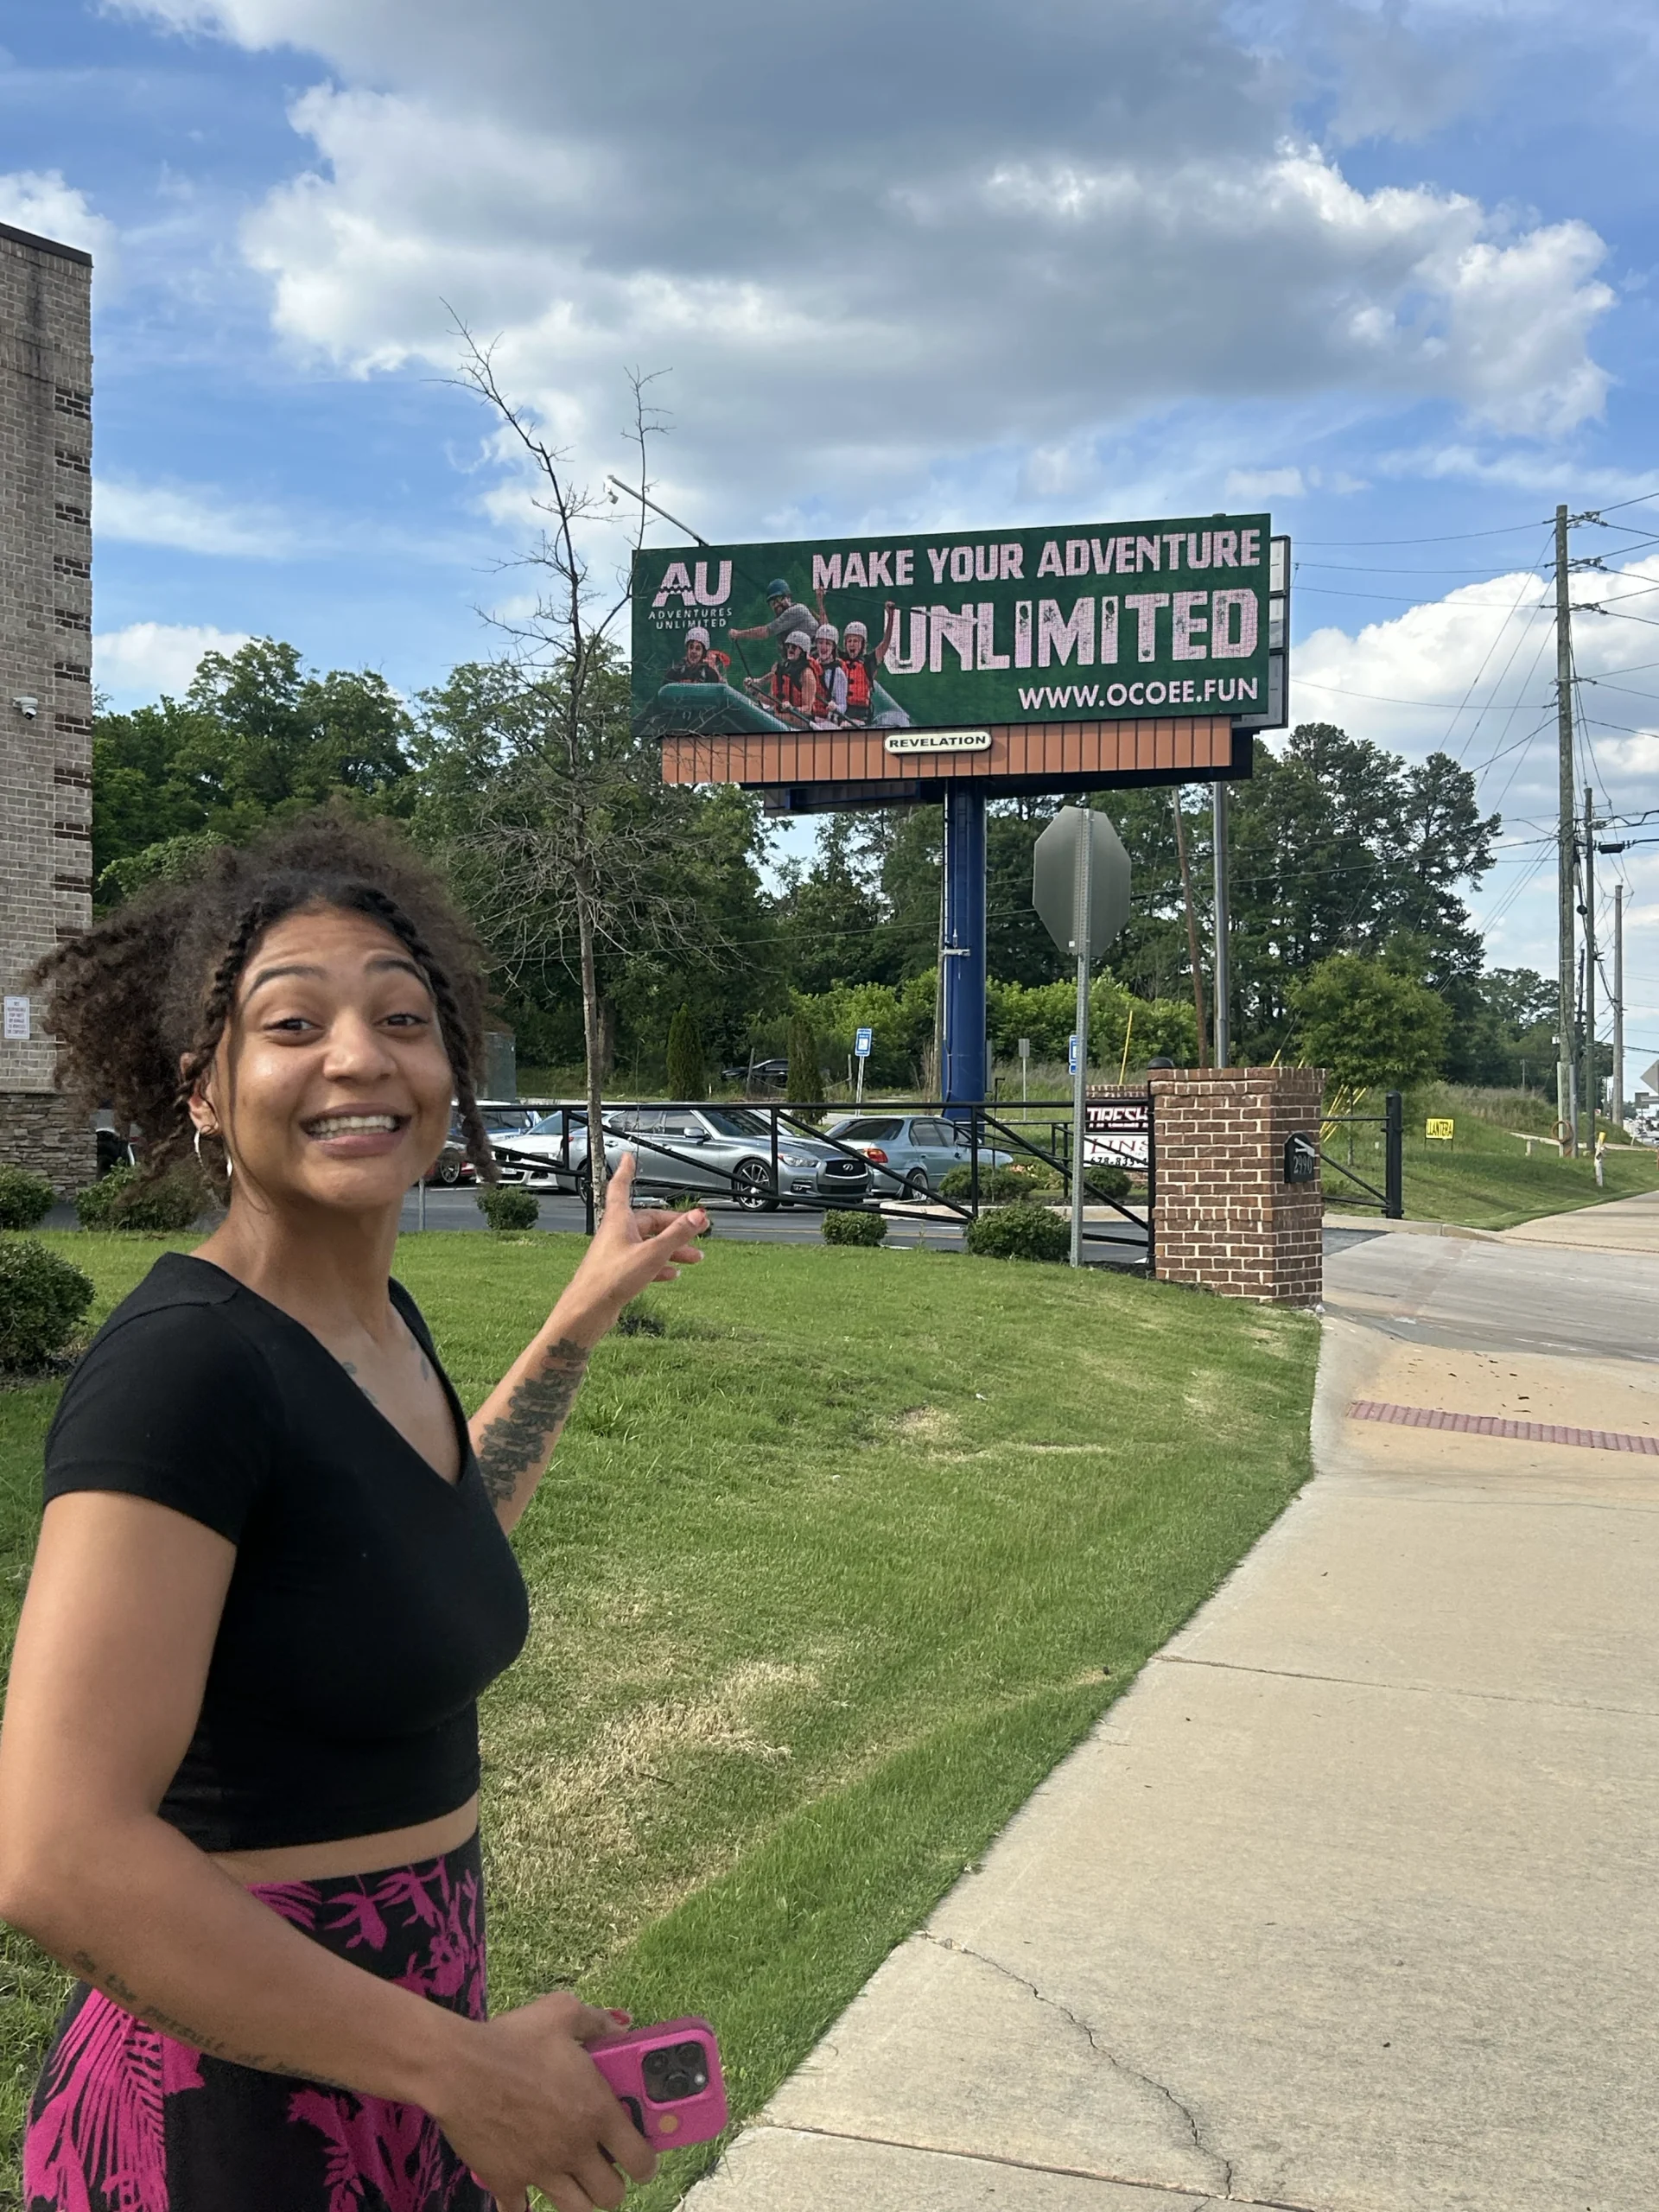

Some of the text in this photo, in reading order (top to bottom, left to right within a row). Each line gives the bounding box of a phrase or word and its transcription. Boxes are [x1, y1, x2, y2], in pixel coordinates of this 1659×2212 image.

[812, 529, 1261, 590] MAKE YOUR ADVENTURE
[652, 560, 733, 607] AU
[648, 607, 733, 620] ADVENTURES
[656, 618, 728, 630] UNLIMITED
[884, 588, 1259, 675] UNLIMITED
[1018, 677, 1258, 710] WWW.OCOEE.FUN
[889, 736, 986, 748] REVELATION
